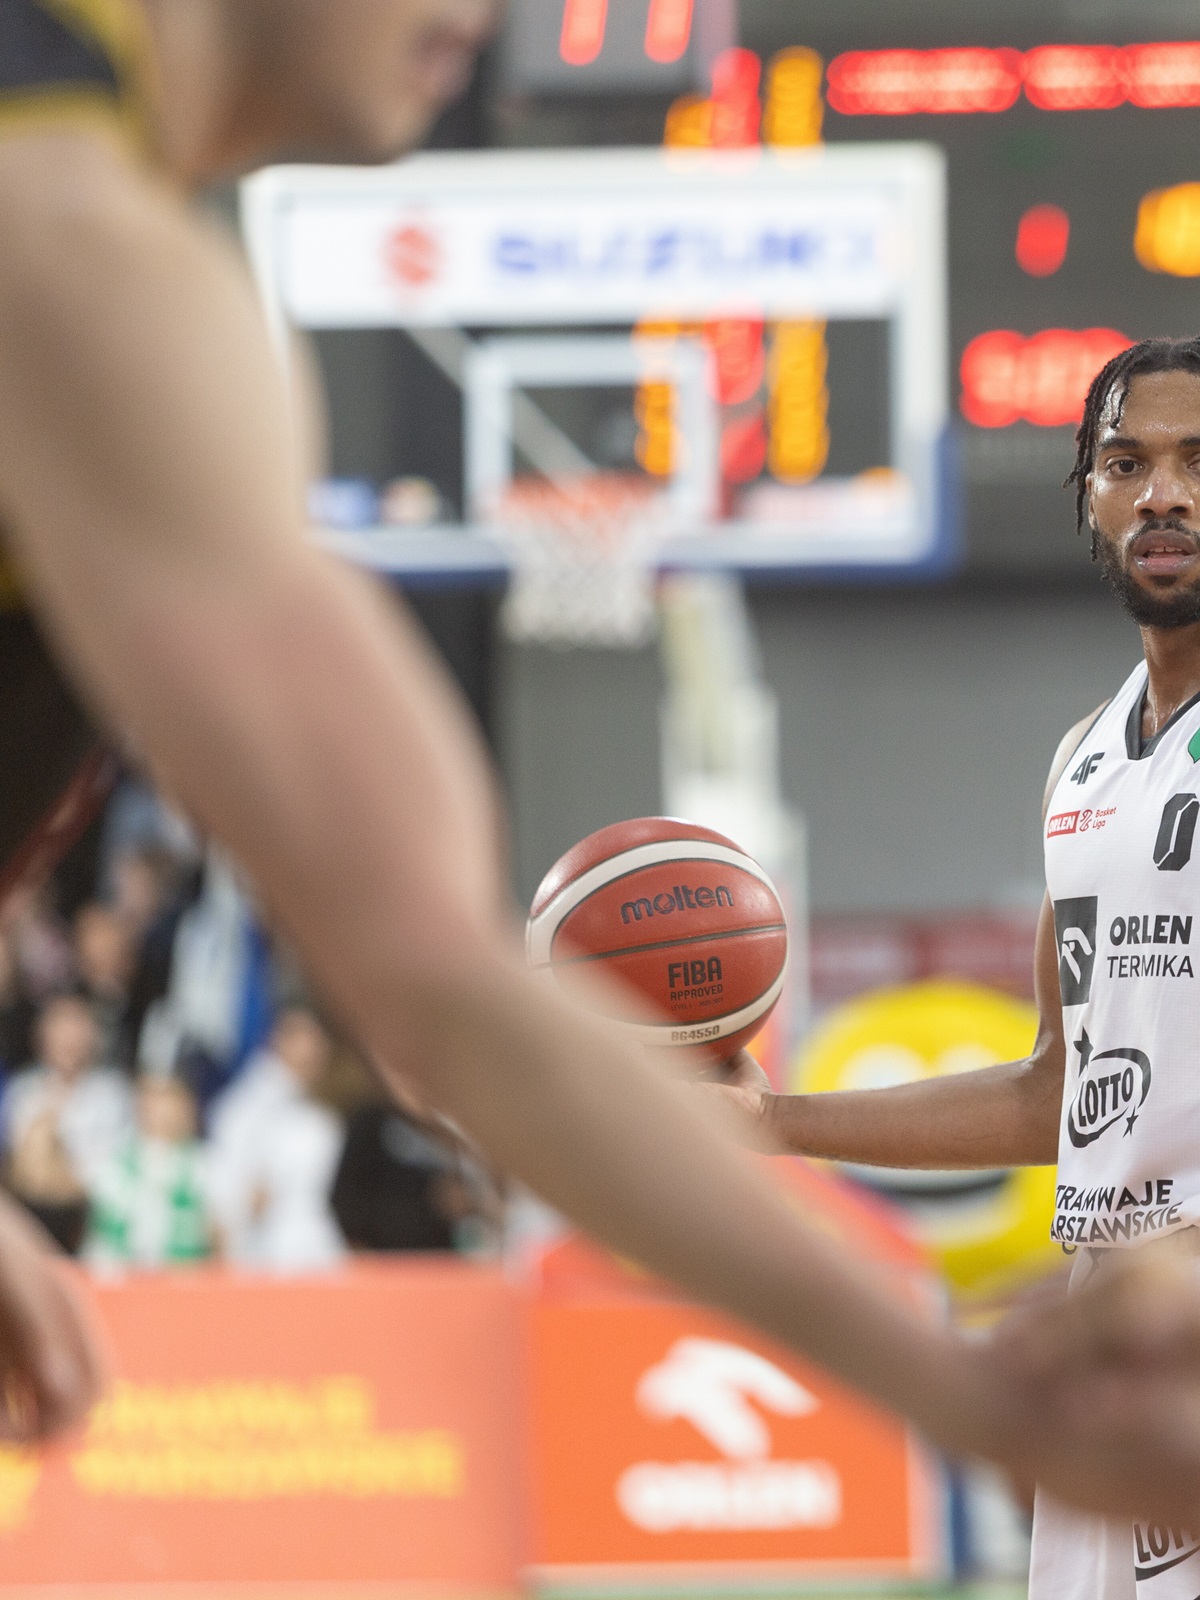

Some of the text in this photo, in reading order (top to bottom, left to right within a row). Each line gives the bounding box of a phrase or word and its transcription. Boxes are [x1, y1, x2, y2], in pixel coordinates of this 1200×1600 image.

[1070, 752, 1105, 785] 4F
[1092, 819, 1106, 830] Liga
[1095, 807, 1117, 819] Basket
[1153, 793, 1200, 871] 0
[620, 885, 735, 925] molten
[1109, 915, 1193, 947] ORLEN
[667, 956, 723, 989] FIBA
[1107, 954, 1195, 979] TERMIKA
[669, 984, 723, 1002] APPROVED
[1077, 1066, 1135, 1128] LOTTO
[1056, 1179, 1174, 1213] TRAMWAJE
[1050, 1201, 1184, 1244] ARSZAWSKIE
